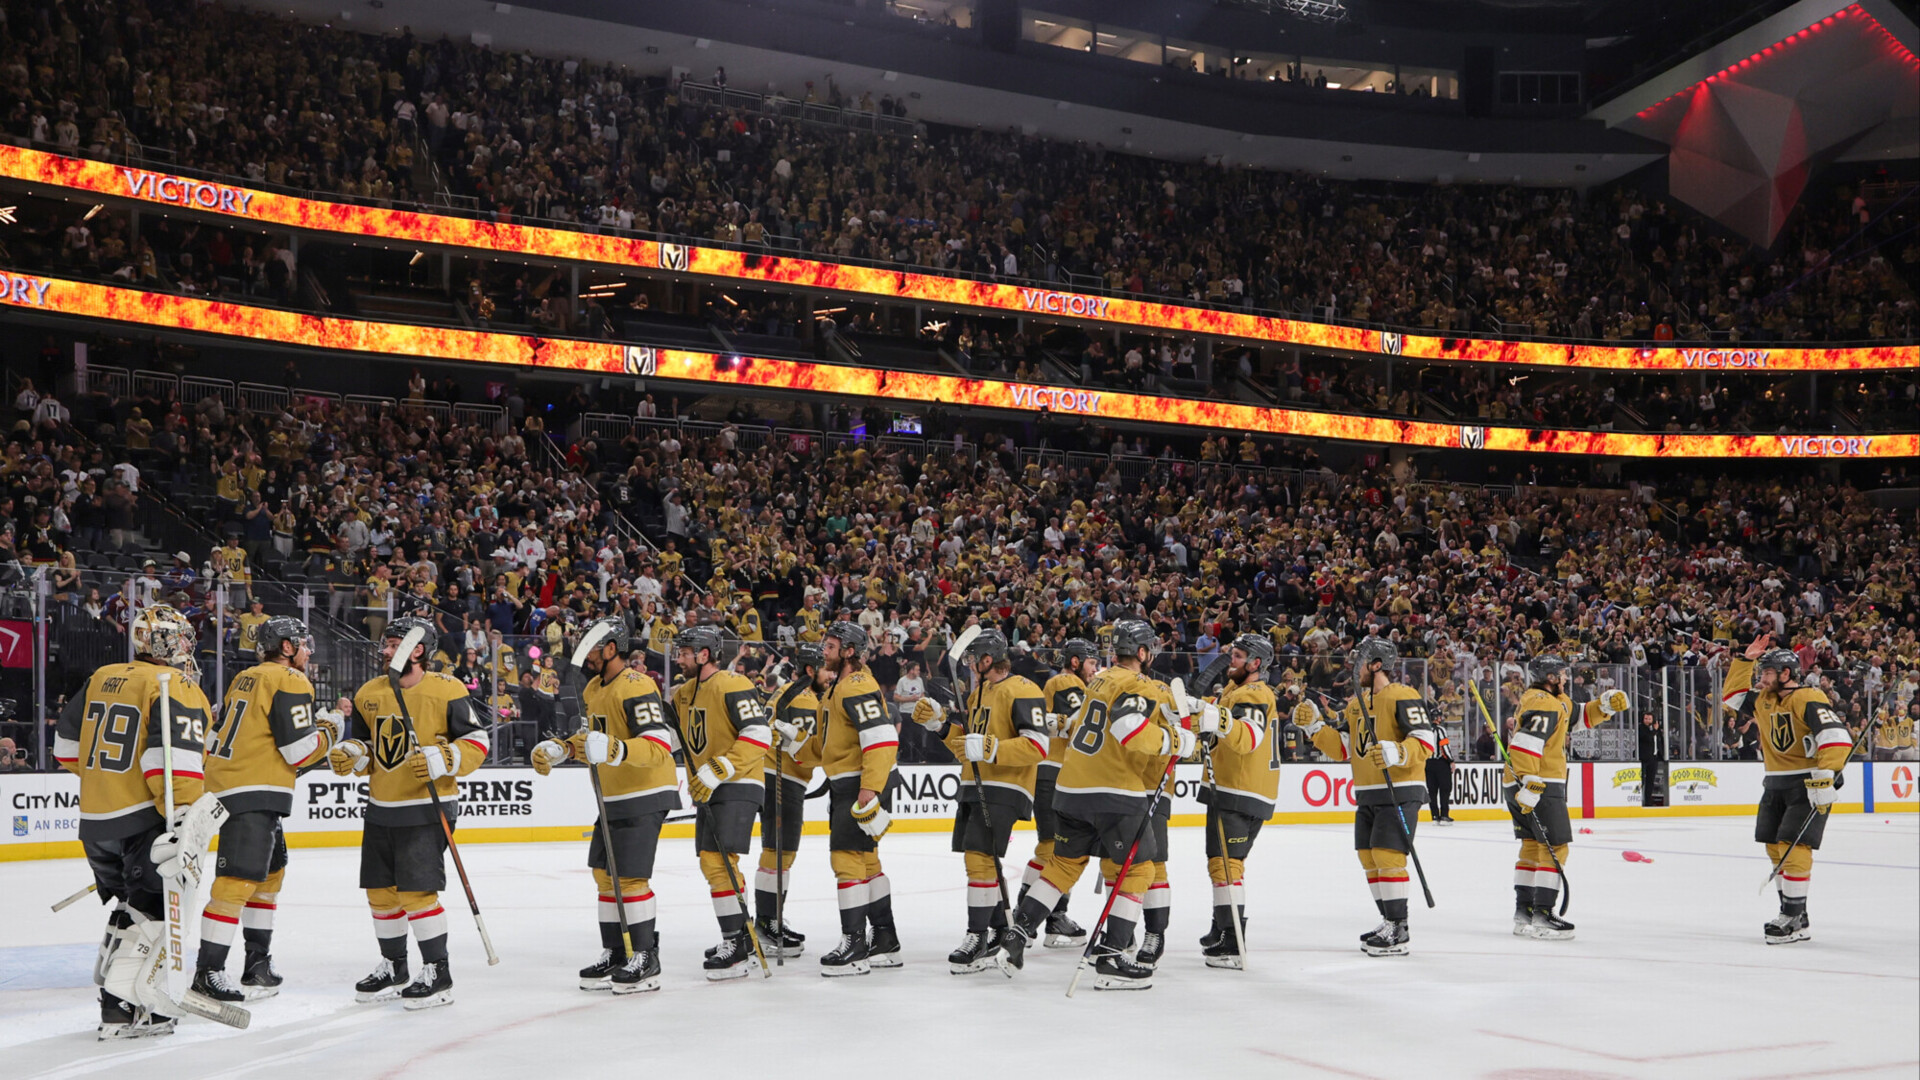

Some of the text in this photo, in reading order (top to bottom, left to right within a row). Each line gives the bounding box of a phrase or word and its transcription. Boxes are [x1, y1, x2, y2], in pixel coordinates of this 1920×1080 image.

[124, 169, 253, 214] VICTORY
[1022, 289, 1109, 317] VICTORY
[1682, 349, 1770, 367] VICTORY
[1009, 385, 1101, 412] VICTORY
[46, 403, 57, 417] 17
[794, 439, 806, 451] 16
[1781, 437, 1873, 455] VICTORY
[101, 676, 129, 695] HART
[290, 703, 312, 730] 21
[634, 702, 663, 726] 55
[736, 699, 763, 721] 22
[854, 699, 881, 723] 15
[1031, 707, 1044, 726] 6
[1244, 708, 1264, 728] 10
[1406, 707, 1430, 726] 52
[176, 715, 205, 744] 79
[1530, 715, 1549, 733] 71
[86, 700, 141, 774] 79
[1618, 771, 1637, 781] GOOD
[1672, 769, 1713, 781] GOOD GREEK
[1805, 780, 1830, 788] CCM
[1448, 768, 1478, 805] GAS
[210, 802, 225, 820] 79
[896, 803, 949, 814] INJURY
[34, 818, 77, 831] AN RBC
[137, 943, 151, 955] 79
